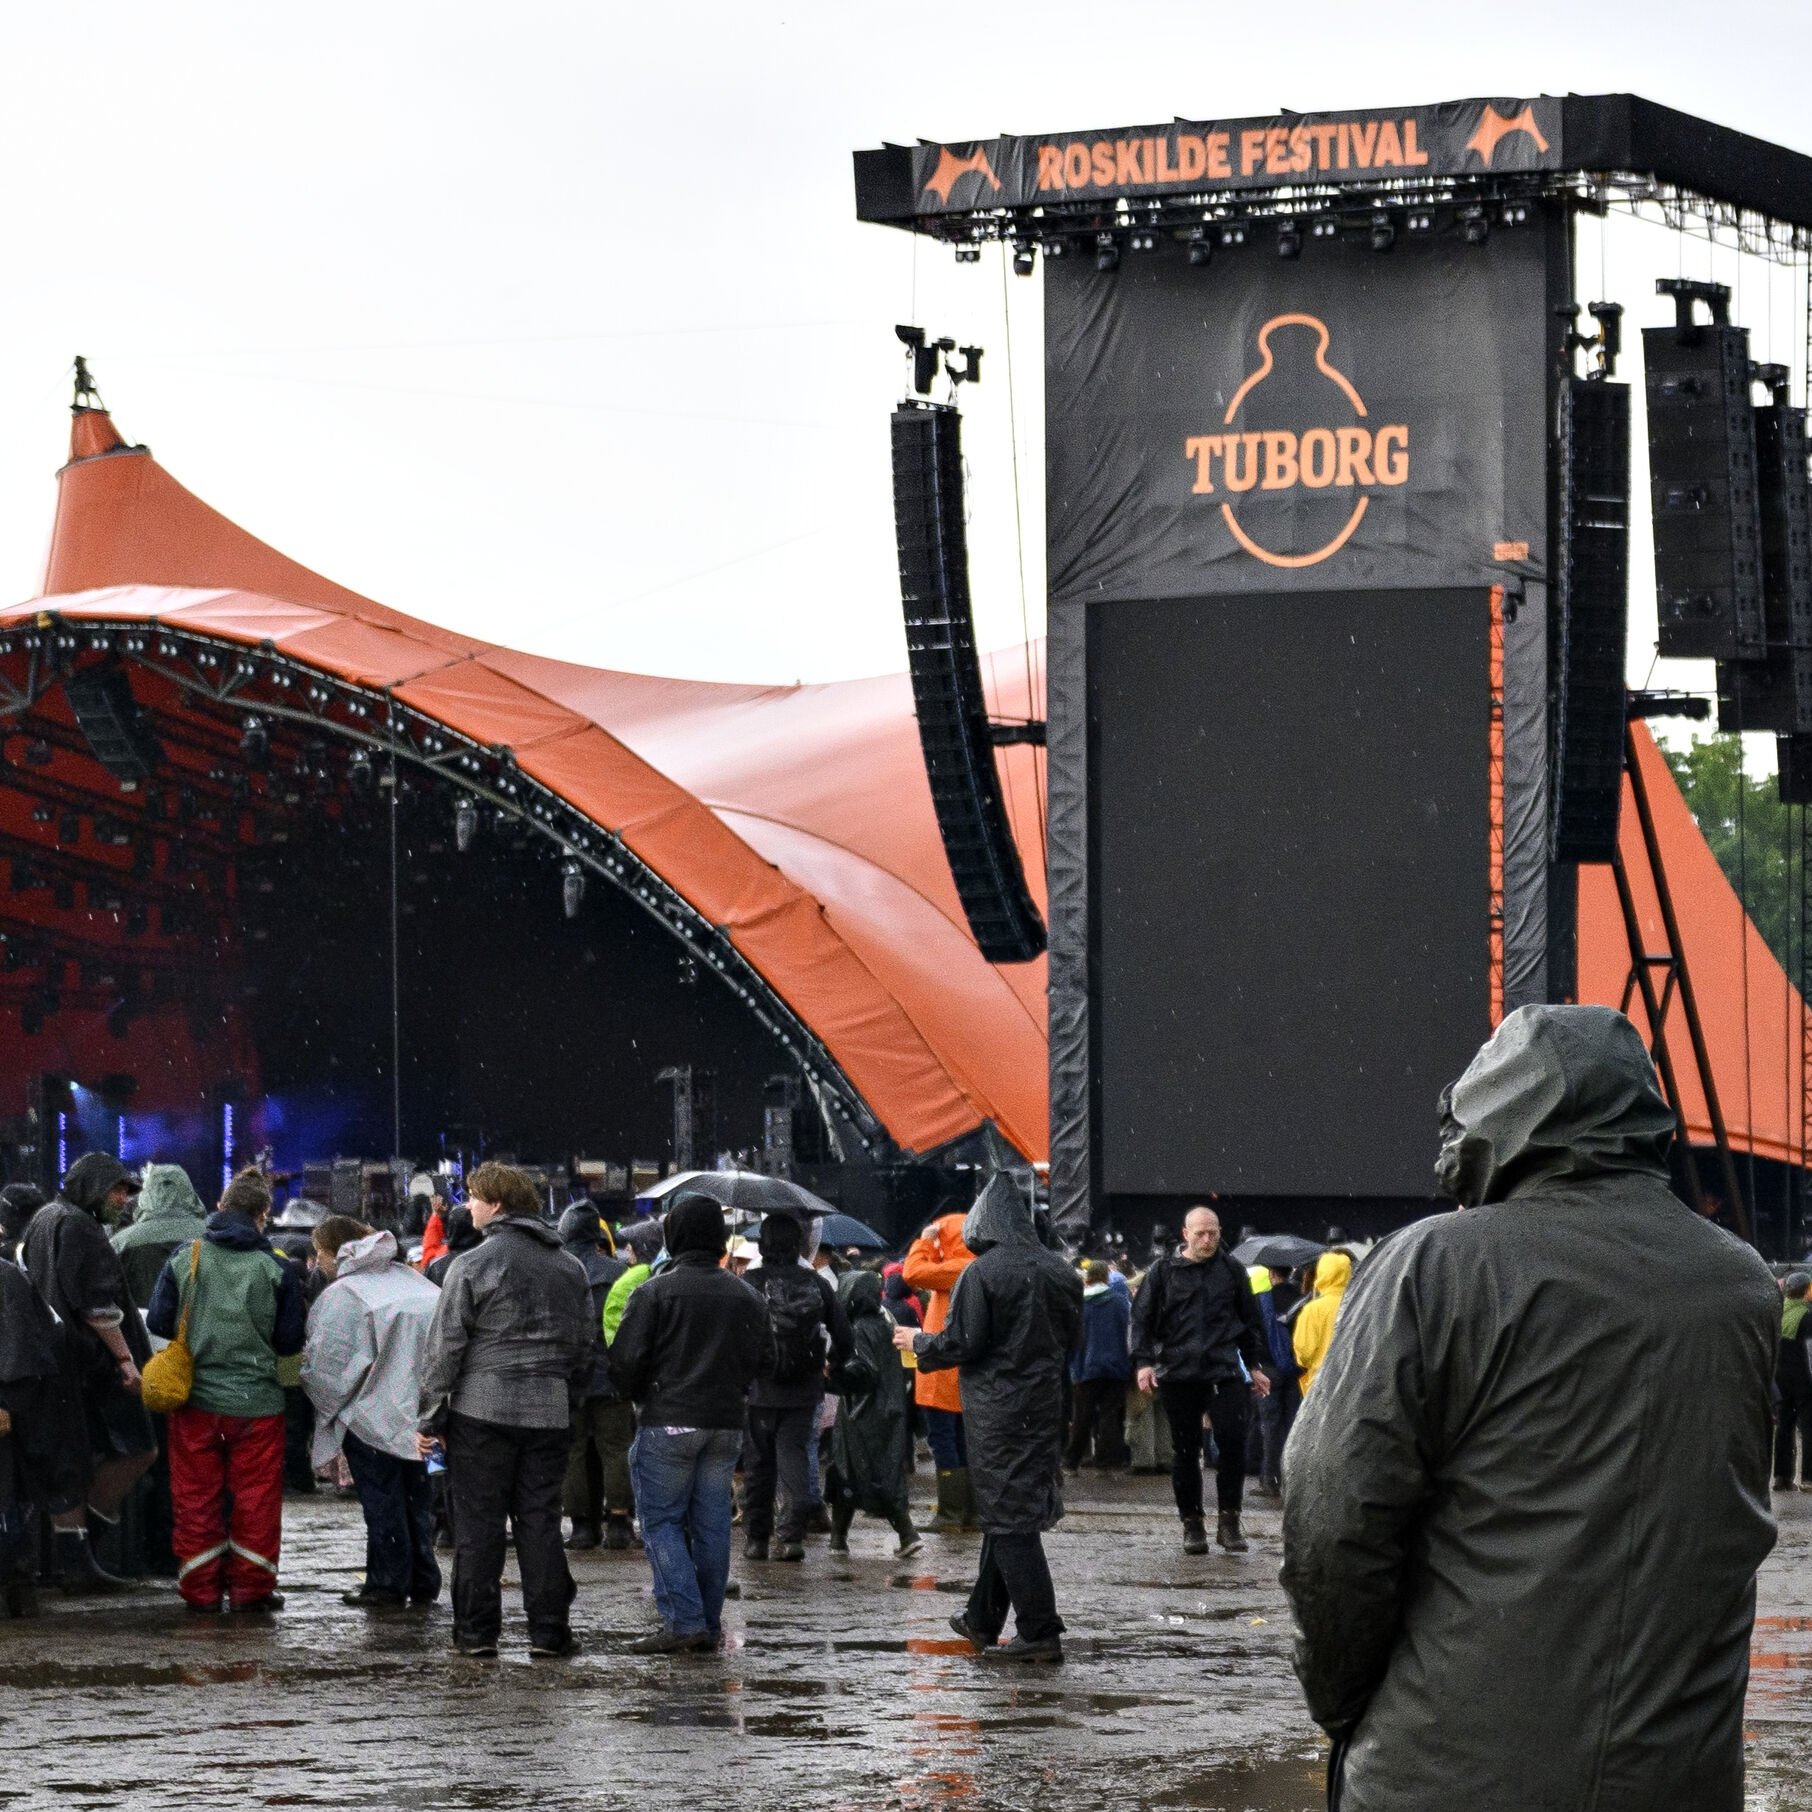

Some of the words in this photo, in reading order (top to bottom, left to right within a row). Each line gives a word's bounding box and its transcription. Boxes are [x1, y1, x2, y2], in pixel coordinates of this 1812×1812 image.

[1038, 132, 1231, 191] ROSKILDE
[1241, 119, 1429, 176] FESTIVAL
[1185, 424, 1409, 494] TUBORG
